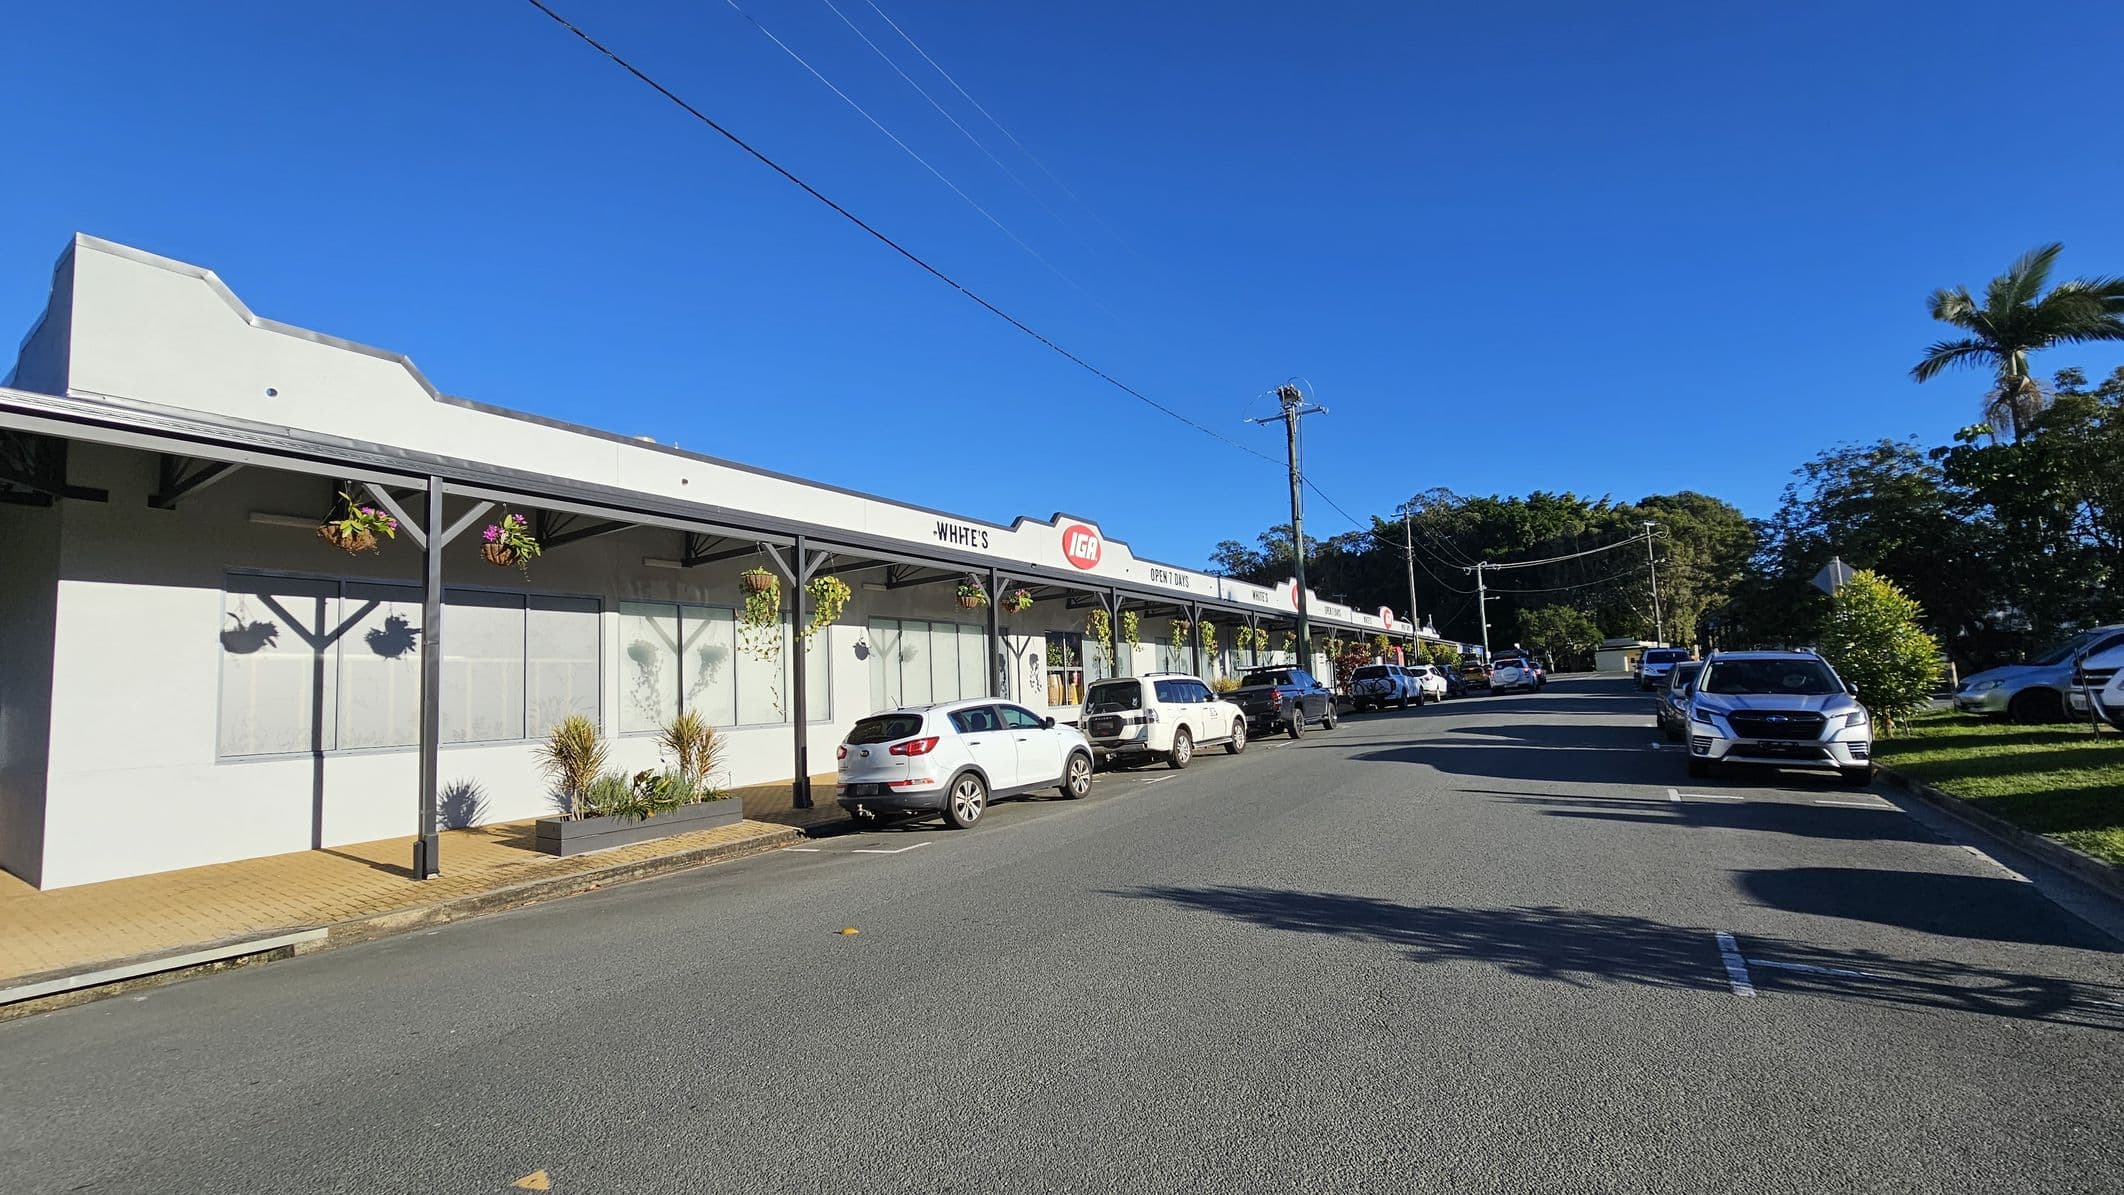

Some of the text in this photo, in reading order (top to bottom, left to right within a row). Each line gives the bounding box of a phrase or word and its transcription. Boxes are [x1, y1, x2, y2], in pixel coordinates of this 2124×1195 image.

[936, 520, 989, 549] WHITE'S
[1070, 531, 1098, 561] IGA
[1150, 568, 1190, 588] OPEN 7 DAYS
